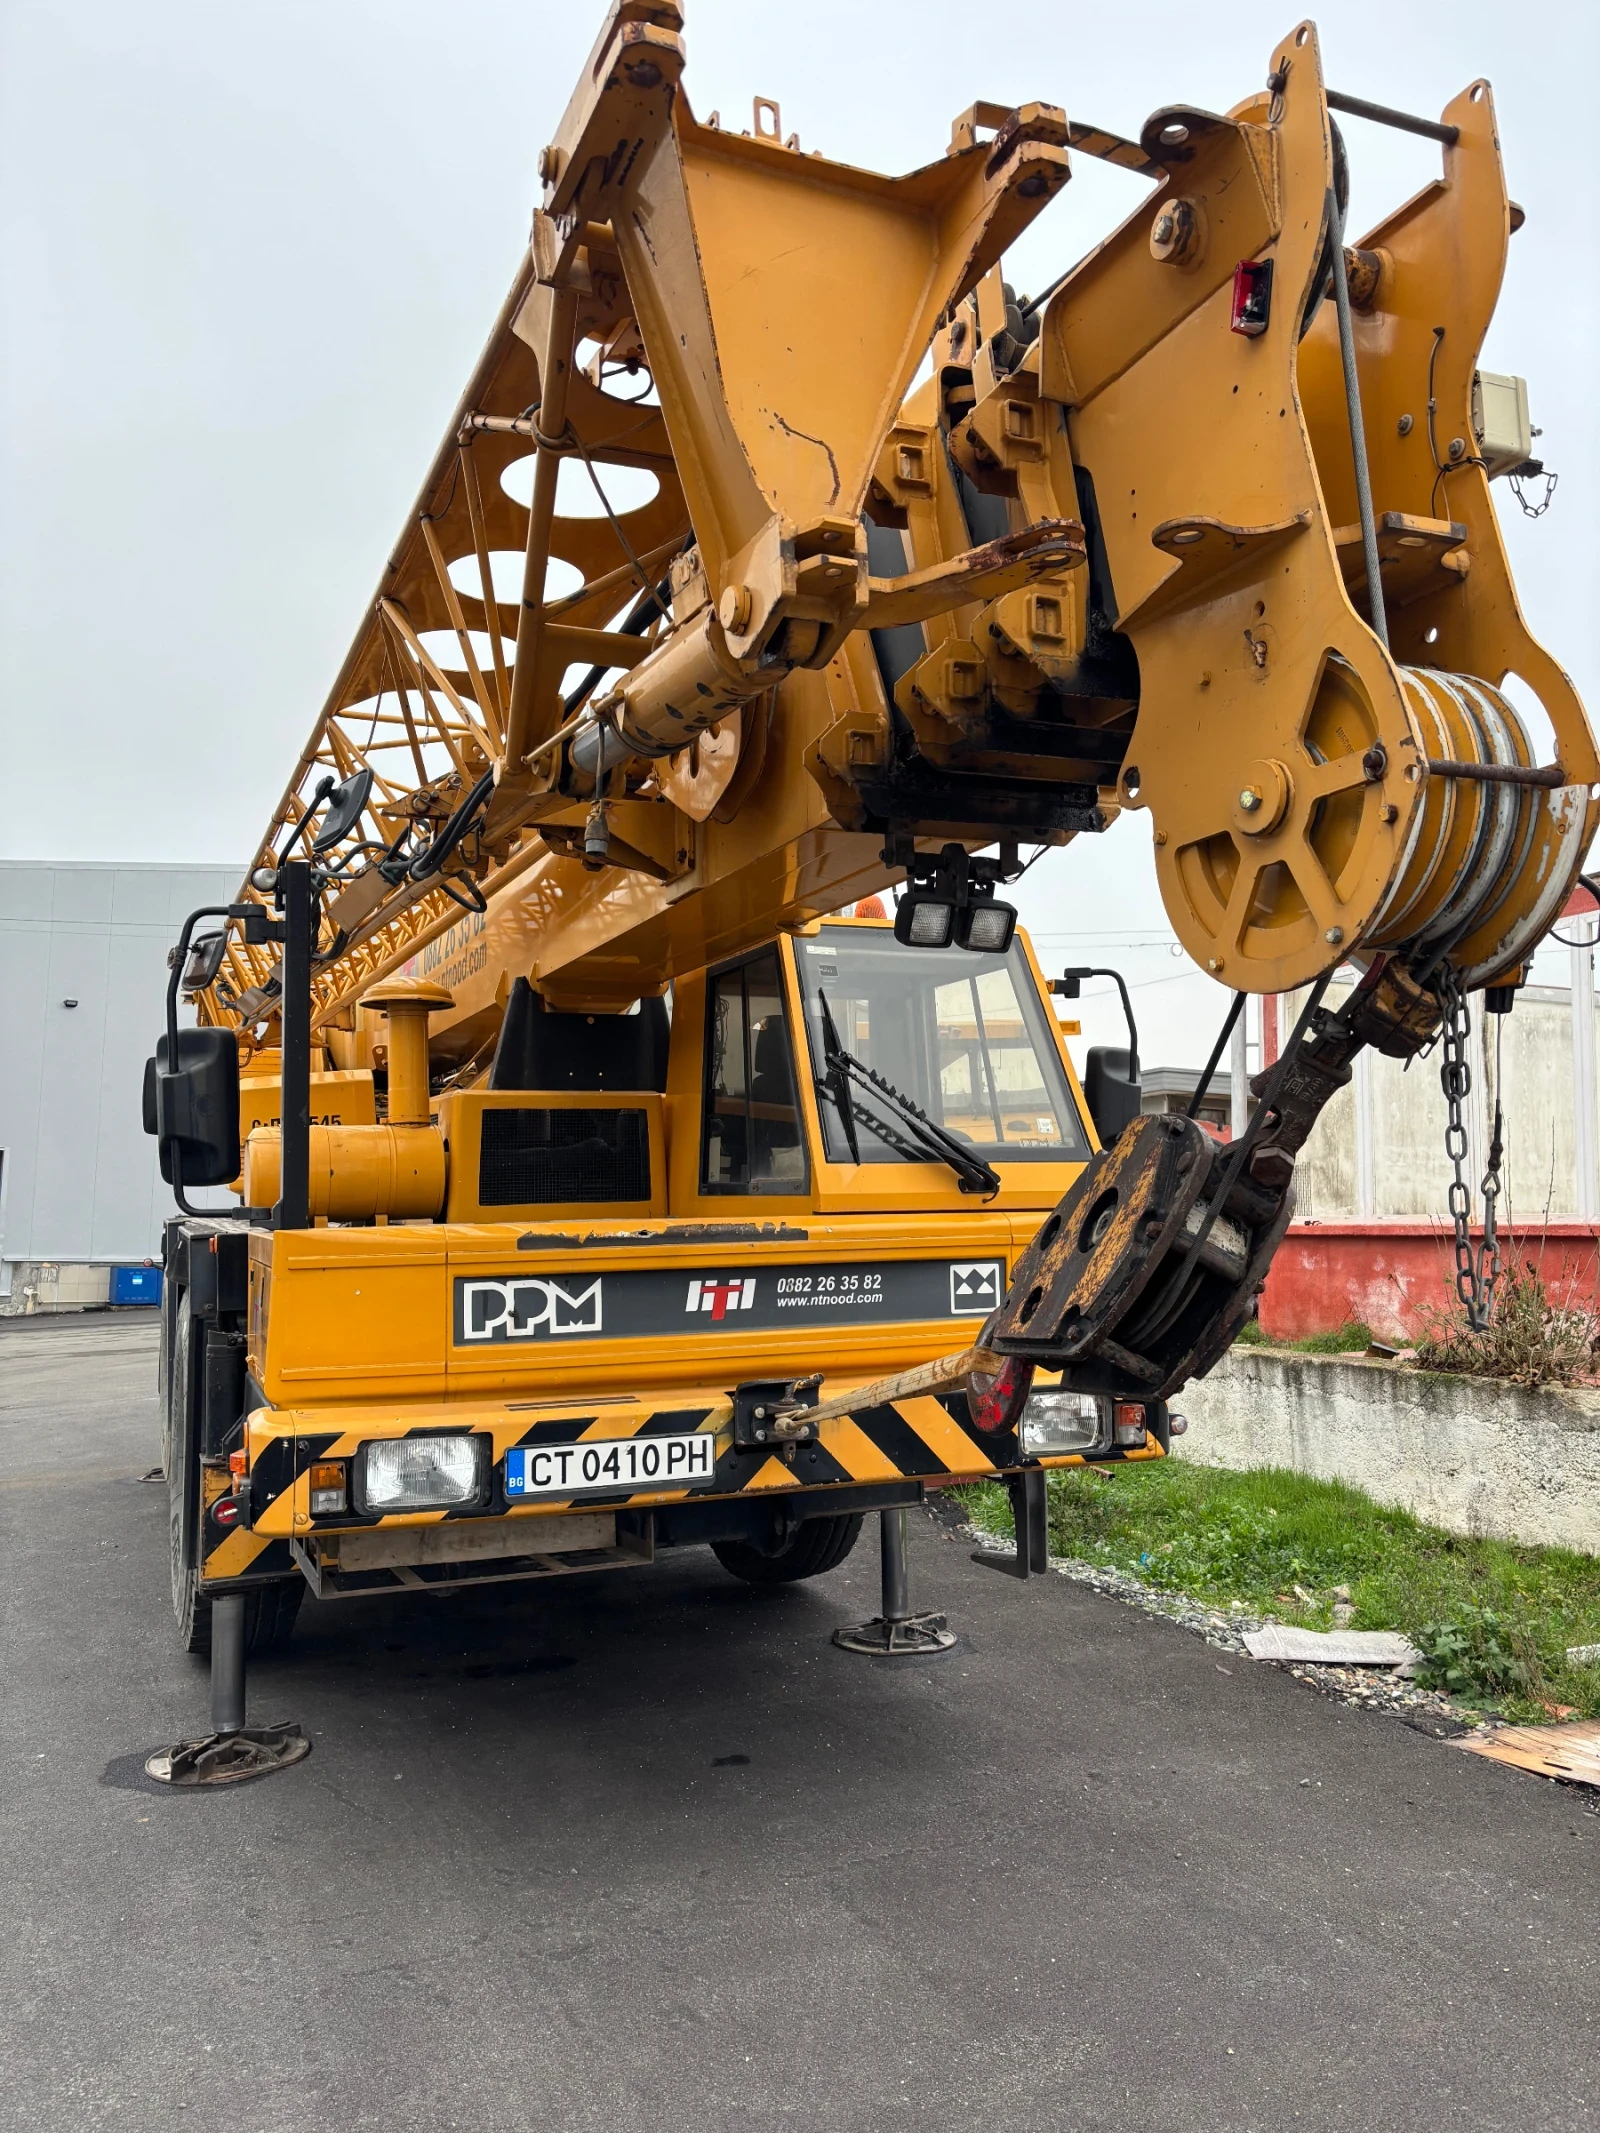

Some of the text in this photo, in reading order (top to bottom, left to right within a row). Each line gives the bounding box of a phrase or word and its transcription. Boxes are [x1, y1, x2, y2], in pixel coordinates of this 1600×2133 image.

[777, 1274, 882, 1293] 0882 26 35 82
[463, 1276, 603, 1340] PPM
[777, 1292, 883, 1308] www.ntnood.com
[508, 1476, 524, 1488] BG
